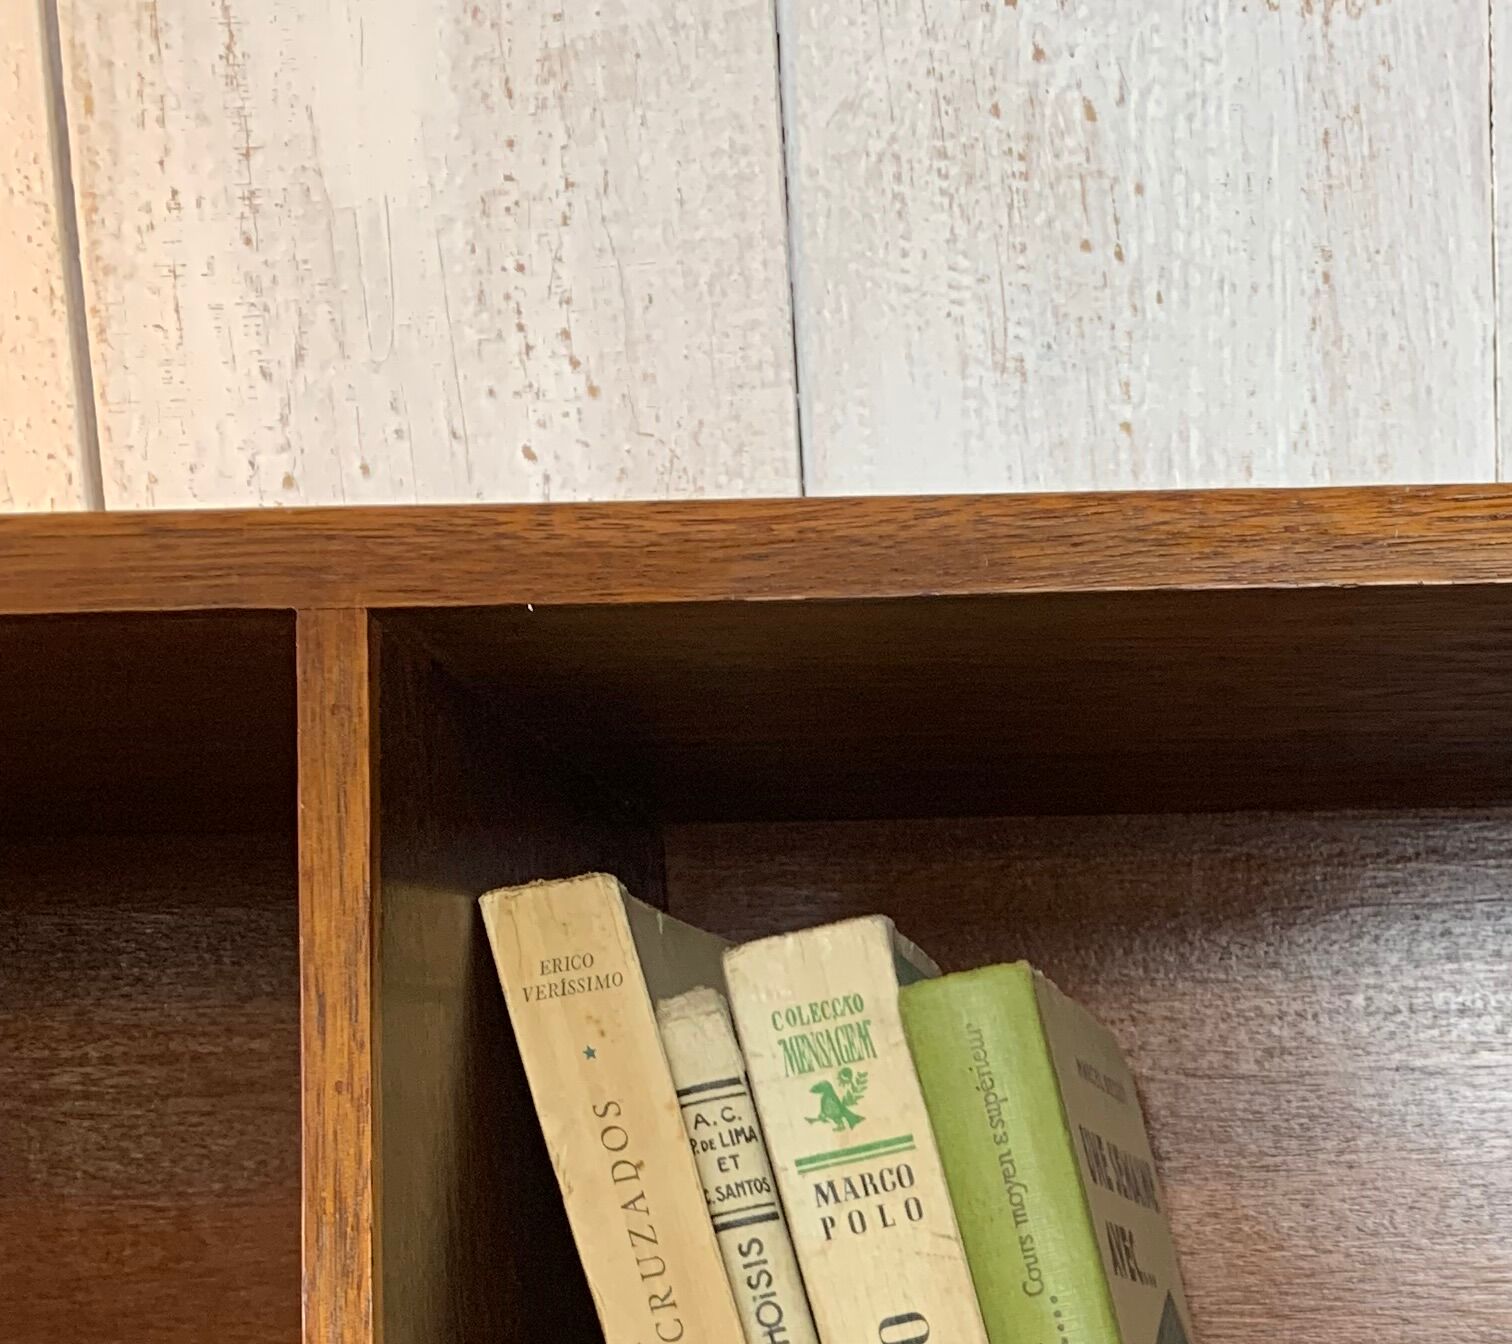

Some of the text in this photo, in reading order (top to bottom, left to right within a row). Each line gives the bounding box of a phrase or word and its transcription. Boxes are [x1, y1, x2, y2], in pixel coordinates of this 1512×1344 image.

[522, 971, 623, 1002] VERÍSSIMO
[540, 952, 594, 976] ERICO
[778, 1019, 877, 1078] MENSAGEM
[718, 1125, 758, 1148] LIMA
[717, 1154, 740, 1173] ET
[813, 1163, 915, 1209] MARCO
[998, 1148, 1029, 1229] moyen
[592, 1100, 684, 1343] CRUZADOS
[820, 1197, 924, 1241] POLO
[1022, 1233, 1045, 1298] Cours
